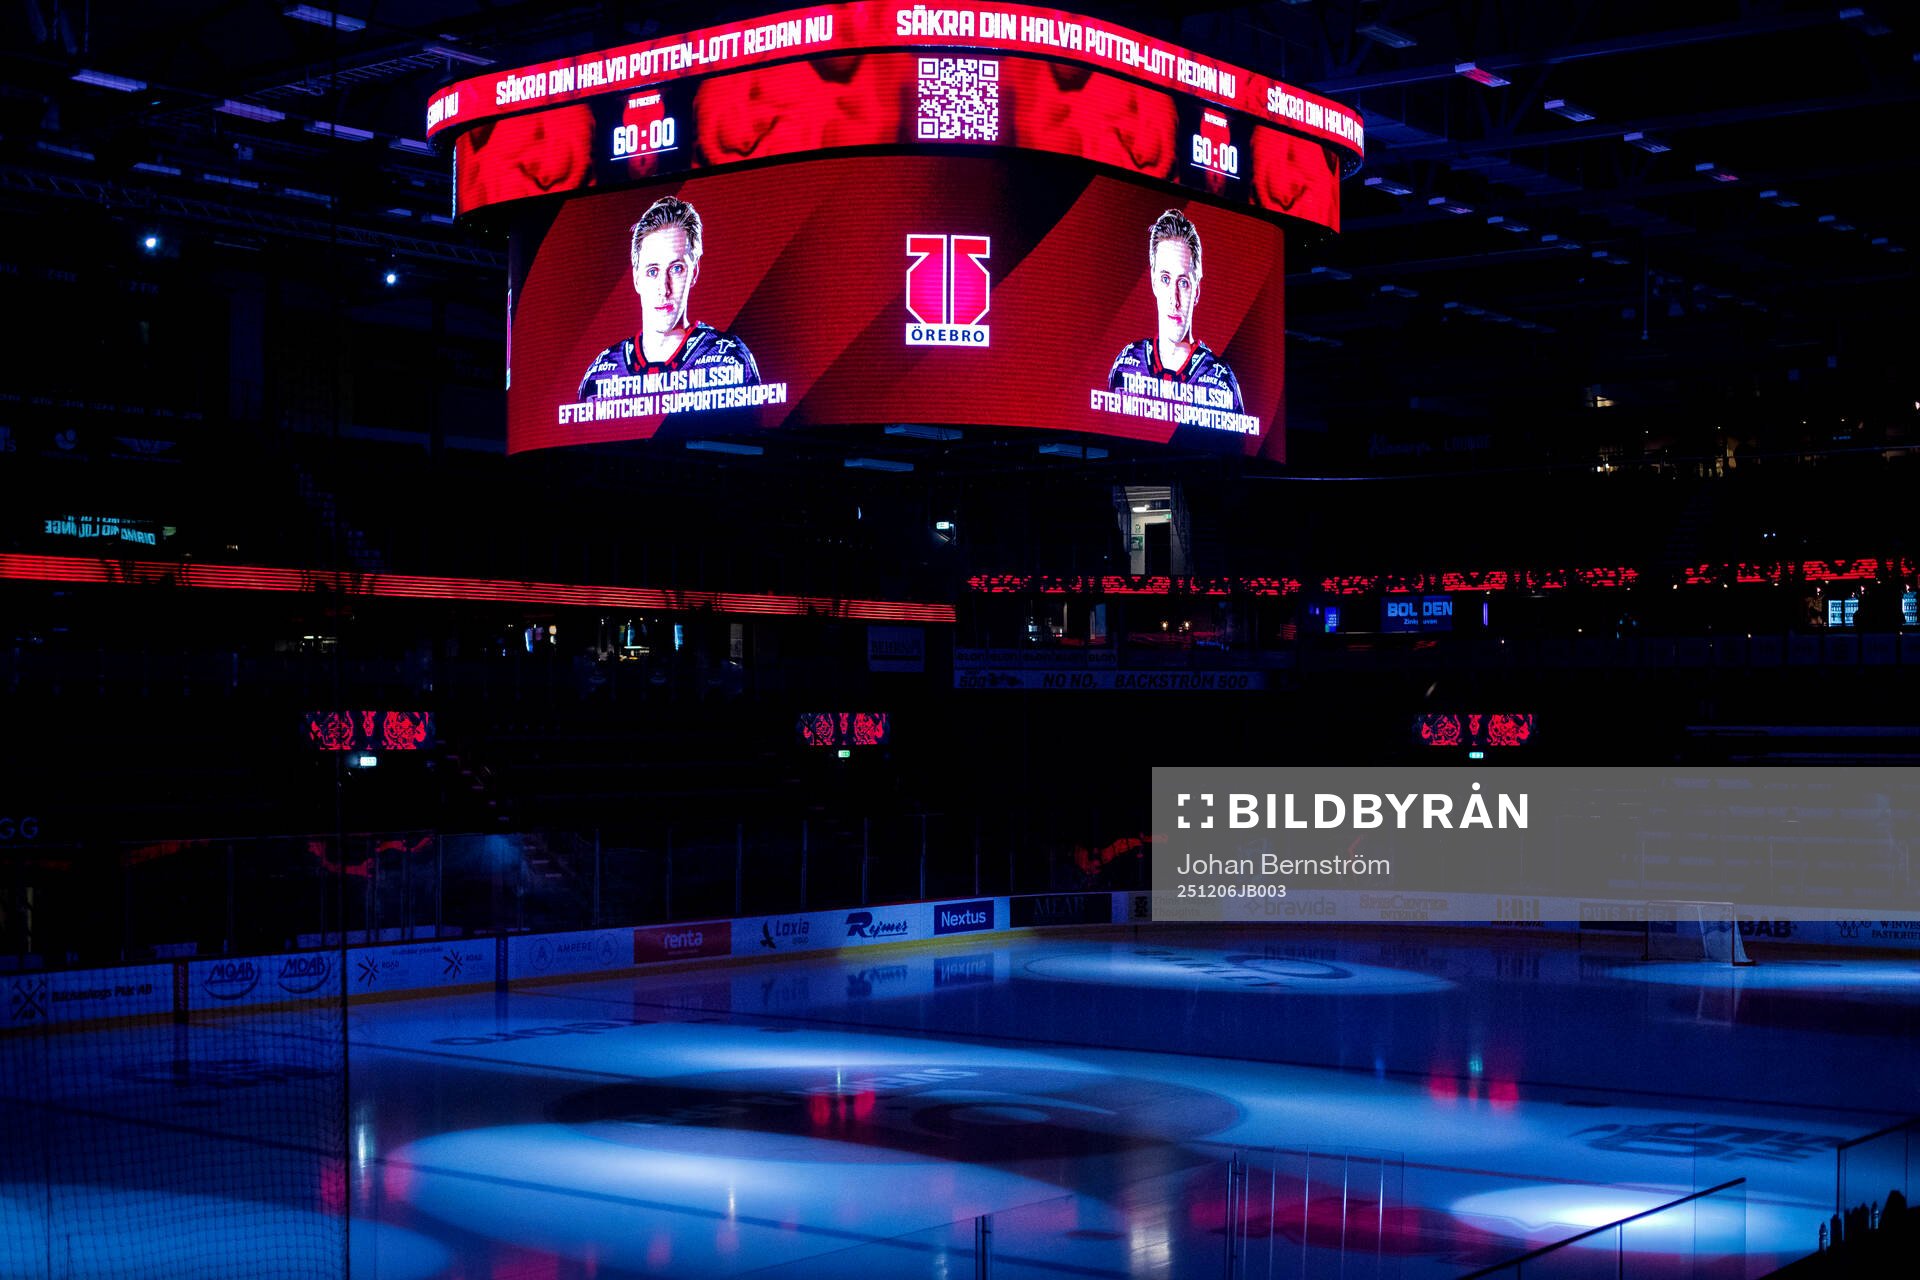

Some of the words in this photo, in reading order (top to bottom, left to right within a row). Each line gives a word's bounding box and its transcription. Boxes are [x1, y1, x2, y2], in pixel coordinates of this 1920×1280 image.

[496, 74, 546, 105] SÄKRA
[548, 66, 575, 95] DIN
[577, 56, 627, 89] HALVA
[629, 31, 741, 79] POTTEN-LOTT
[743, 19, 802, 56] REDAN
[805, 14, 833, 44] NU
[897, 5, 975, 37] SÄKRA
[979, 11, 1016, 40] DIN
[1020, 16, 1082, 51] HALVA
[1085, 26, 1175, 79] POTTEN-LOTT
[1177, 56, 1217, 94] REDAN
[1218, 70, 1236, 99] NU
[445, 92, 459, 119] NU
[1267, 85, 1304, 122] SÄKRA
[1305, 100, 1323, 130] DIN
[1324, 107, 1353, 141] HALVA
[613, 117, 675, 156] 60:00
[1193, 133, 1238, 174] 60:00
[911, 325, 985, 342] ÖREBRO
[595, 373, 642, 399] TRÄFFA
[643, 369, 688, 395] NIKLAS
[689, 363, 744, 388] NILSSON
[1122, 371, 1159, 398] TRÄFFA
[1159, 379, 1194, 405] NIKLAS
[1194, 384, 1234, 410] NILSSON
[558, 402, 594, 424] EFTER
[595, 396, 651, 421] MATCHEN
[655, 395, 660, 415] I
[661, 383, 787, 415] SUPPORTERSHOPEN
[1090, 389, 1122, 414] EFTER
[1122, 394, 1168, 421] MATCHEN
[1169, 402, 1173, 422] I
[1173, 403, 1260, 436] SUPPORTERSHOPEN
[775, 918, 810, 938] Loxia
[940, 908, 987, 928] Nextus
[663, 930, 704, 949] renta
